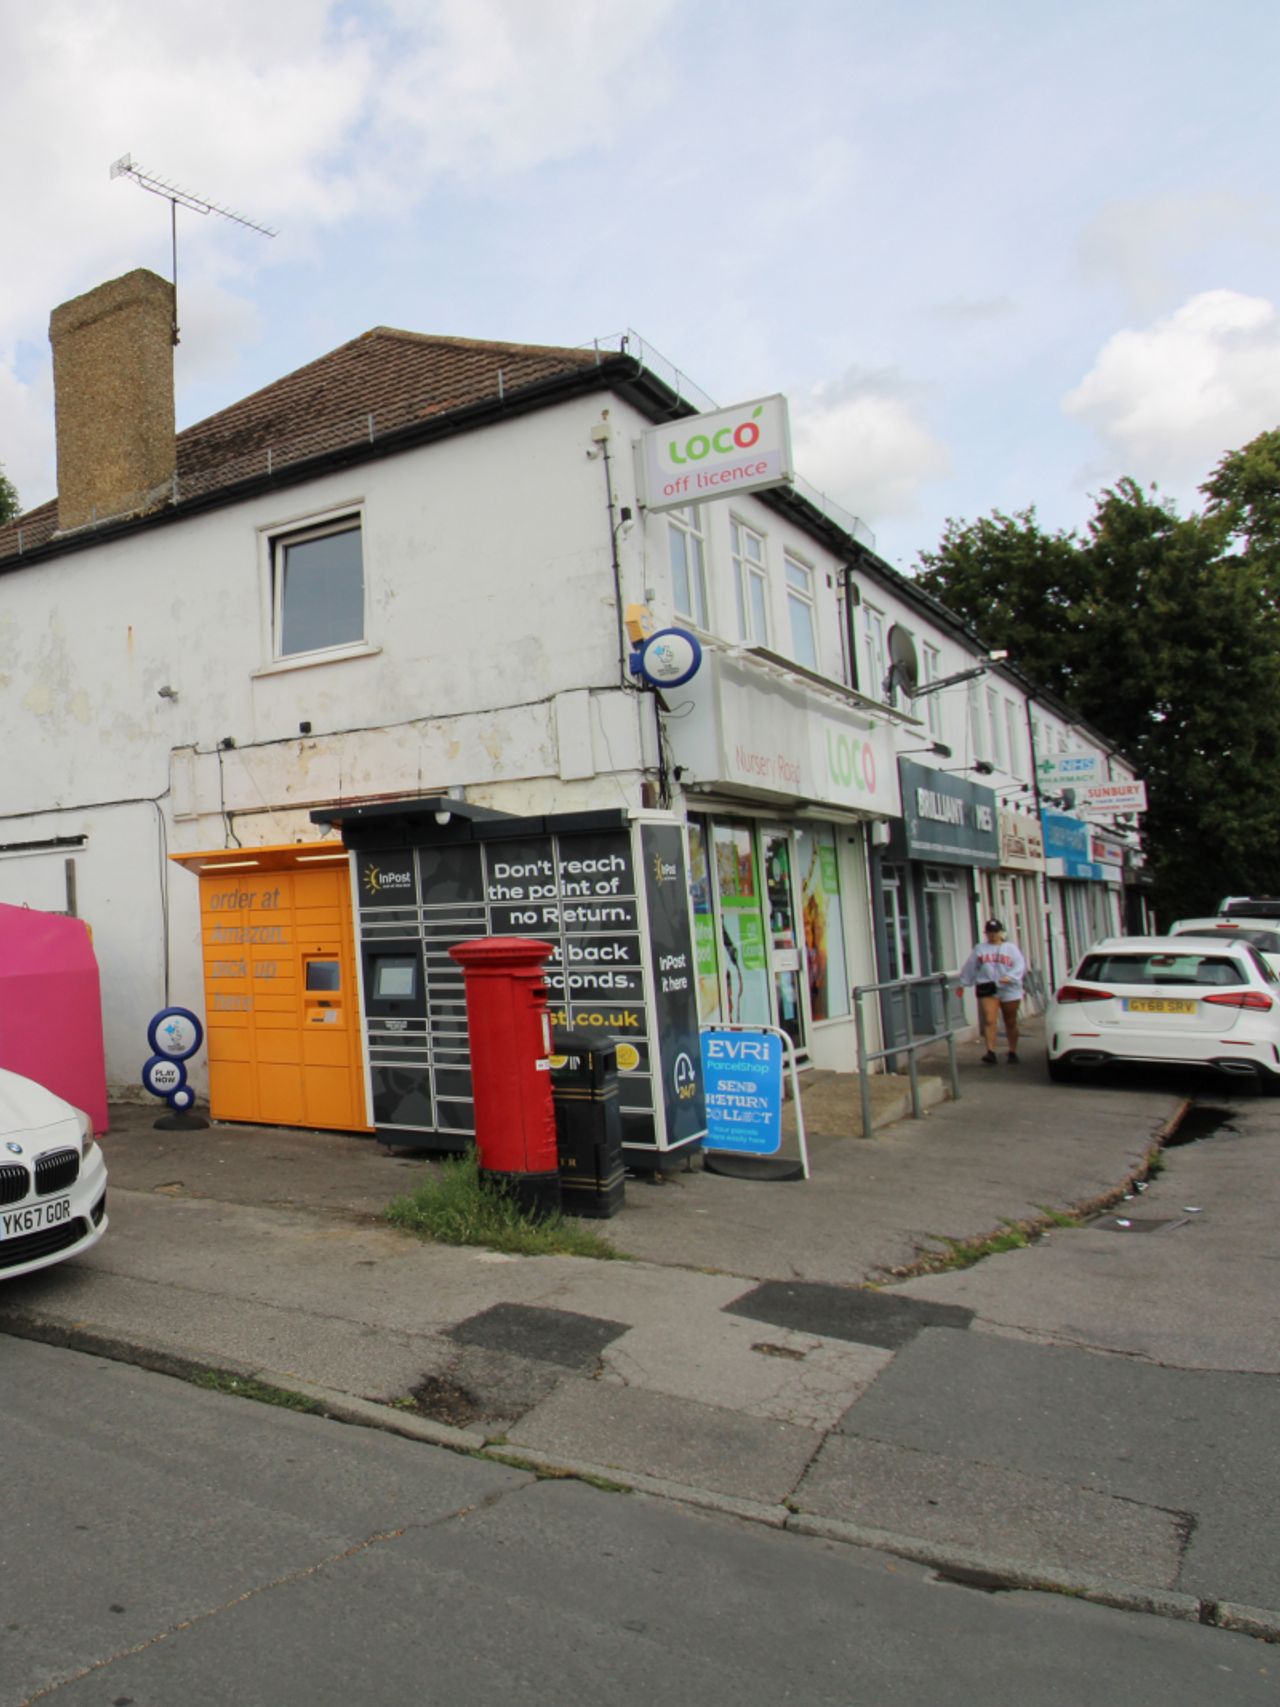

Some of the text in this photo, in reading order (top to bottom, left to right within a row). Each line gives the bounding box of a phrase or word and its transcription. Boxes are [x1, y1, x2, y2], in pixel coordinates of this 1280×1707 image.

[669, 422, 760, 464] LOCO
[663, 461, 768, 496] off licence
[826, 729, 876, 794] LOCO
[1088, 784, 1139, 798] SUNBURY
[917, 787, 964, 826] BRILLIANT
[494, 854, 625, 879] Don't reach
[378, 871, 411, 884] InPost
[487, 876, 620, 901] the point of
[209, 888, 281, 911] order at
[510, 905, 632, 925] no Return.
[568, 943, 629, 960] back
[211, 956, 278, 982] pick up
[659, 952, 687, 971] InPost
[543, 971, 635, 989] econds.
[669, 975, 688, 991] here
[213, 989, 254, 1012] here
[549, 1010, 639, 1028] st.co.uk
[155, 1069, 176, 1077] PLAY
[707, 1061, 769, 1074] ParcelShop
[678, 1083, 696, 1099] 24/7
[717, 1080, 757, 1093] SEND
[705, 1092, 769, 1109] RETURN
[3, 1199, 71, 1235] YK67 GOR
